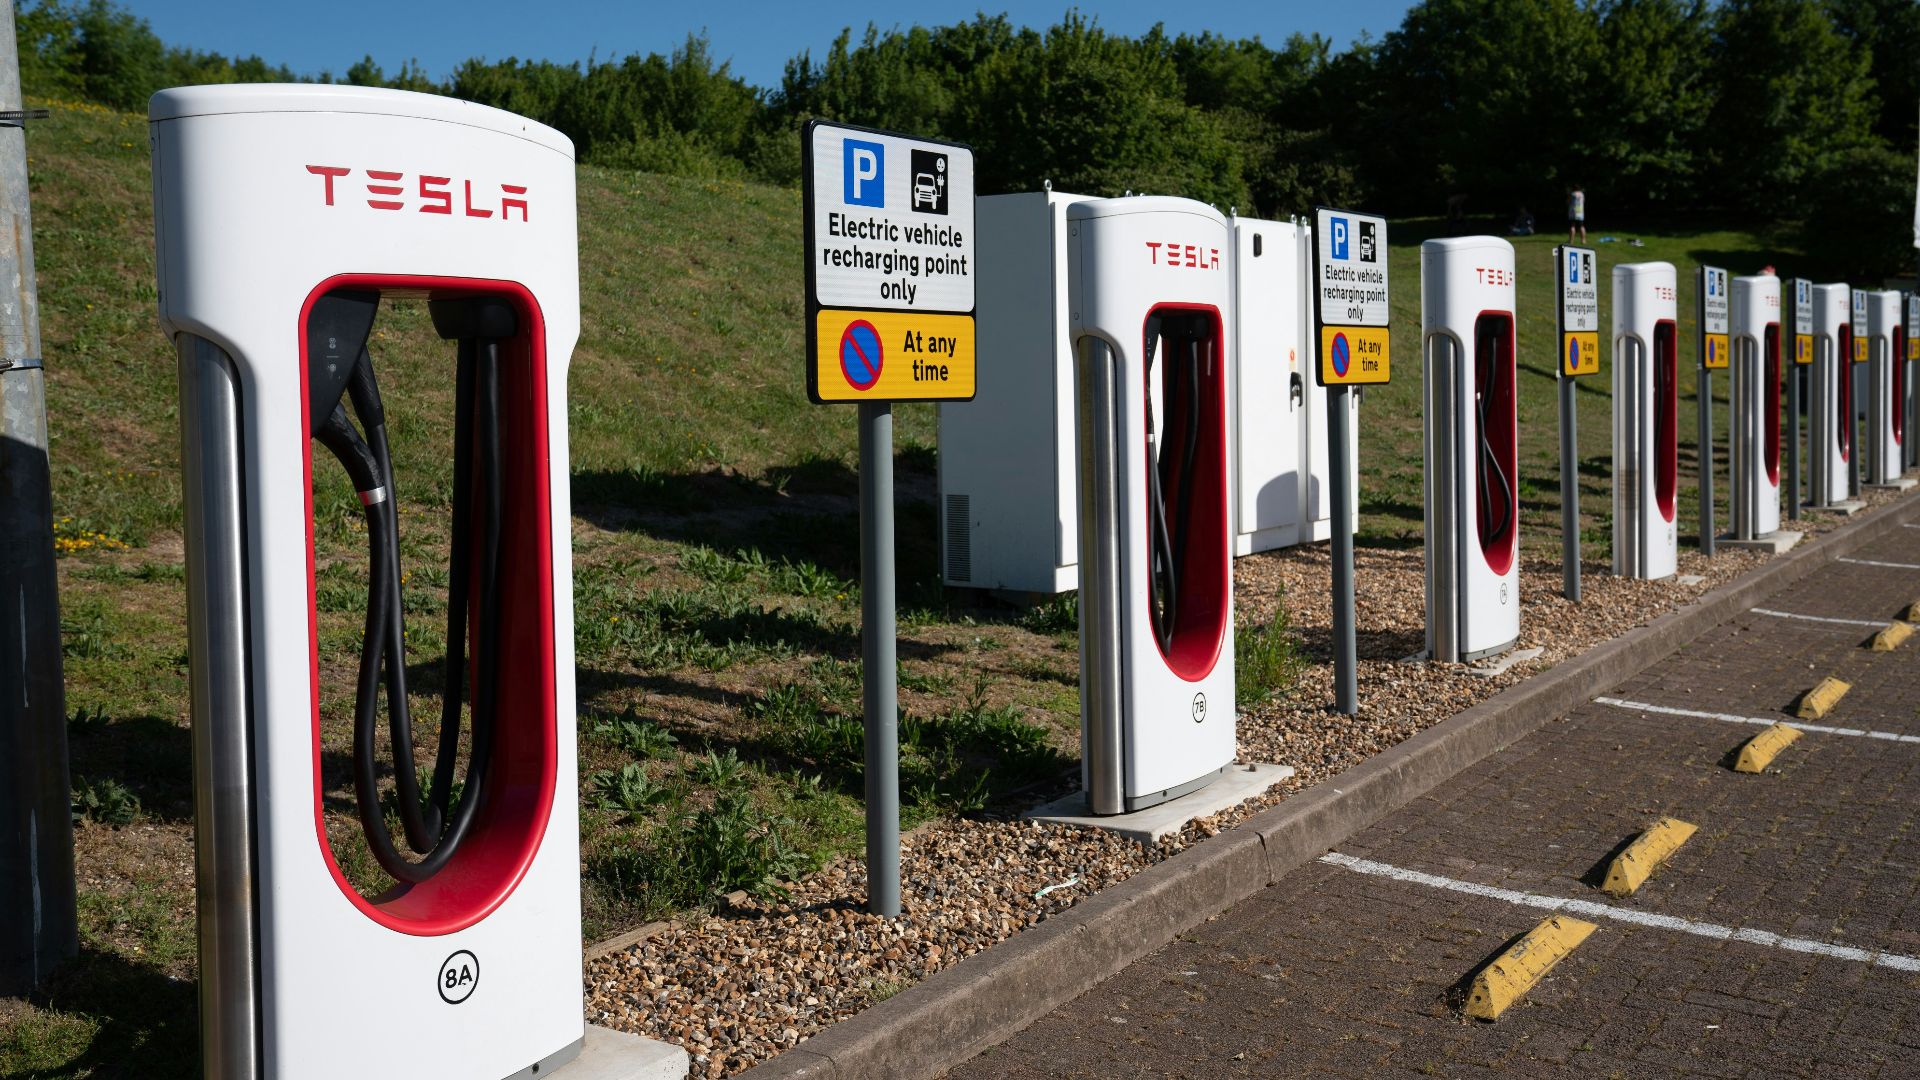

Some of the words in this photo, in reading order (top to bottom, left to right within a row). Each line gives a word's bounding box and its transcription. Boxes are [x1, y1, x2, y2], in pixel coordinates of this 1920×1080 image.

[853, 148, 877, 199] P
[305, 165, 528, 222] TESLA
[828, 213, 899, 242] Electric
[904, 223, 963, 248] vehicle
[1334, 222, 1346, 256] P
[823, 245, 919, 277] recharging
[925, 254, 968, 277] point
[1145, 242, 1219, 270] TESLA
[1325, 264, 1355, 282] Electric
[1357, 269, 1383, 284] vehicle
[880, 278, 917, 305] only
[1323, 284, 1364, 304] recharging
[1366, 288, 1386, 304] point
[1347, 305, 1364, 322] only
[903, 330, 923, 353] At
[928, 336, 957, 358] any
[1358, 338, 1367, 353] At
[1368, 341, 1382, 355] any
[912, 360, 949, 382] time
[1362, 357, 1379, 372] time
[1195, 701, 1204, 714] 7B
[446, 964, 473, 988] 8A
